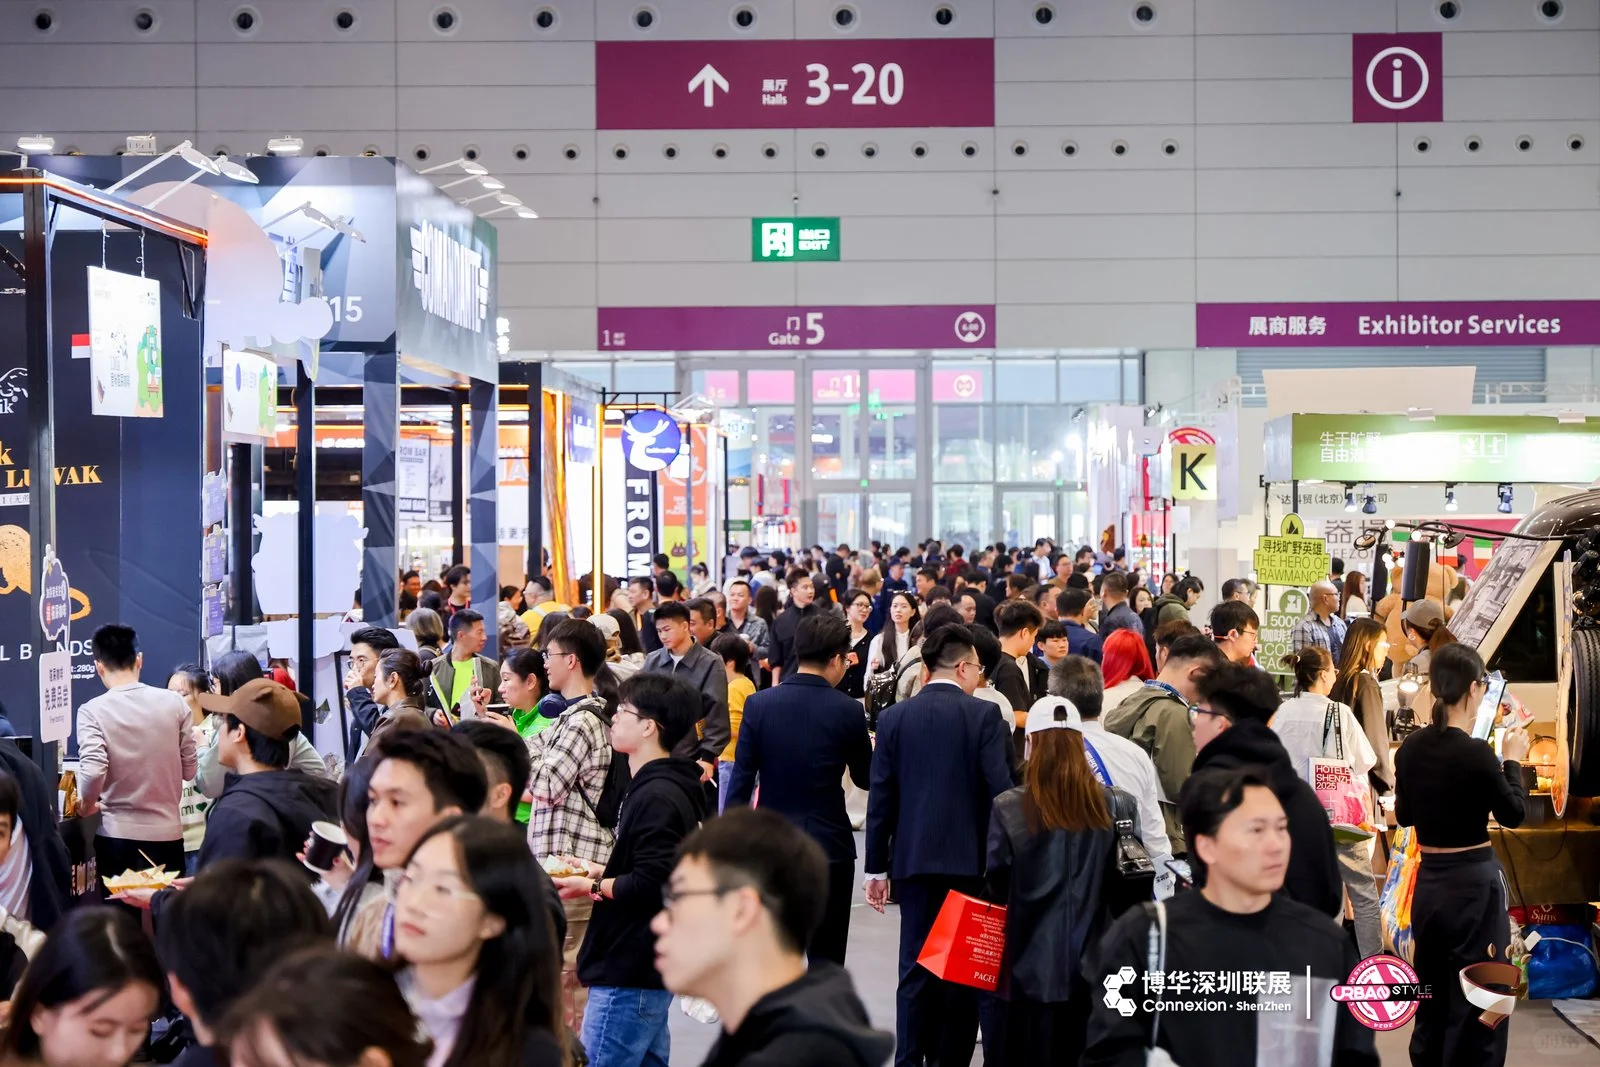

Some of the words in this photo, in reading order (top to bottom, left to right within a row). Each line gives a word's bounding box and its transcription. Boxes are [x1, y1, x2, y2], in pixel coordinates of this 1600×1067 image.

[762, 79, 788, 92] 展厅
[805, 62, 905, 106] 3-20
[762, 94, 788, 105] Halls
[799, 240, 830, 250] EXIT
[786, 316, 800, 331] 门
[805, 312, 825, 345] 5
[1248, 315, 1327, 336] 展商服务
[1358, 314, 1463, 335] Exhibitor
[1467, 313, 1562, 335] Services
[768, 332, 800, 345] Gate
[1180, 452, 1208, 491] K
[626, 477, 652, 578] FROM
[1263, 540, 1323, 556] 寻找旷野英雄
[1256, 553, 1277, 568] THE
[1279, 556, 1311, 570] HERO
[1313, 557, 1330, 570] OF
[1316, 765, 1351, 775] HOTELE
[1316, 773, 1351, 784] SHENZH
[1316, 782, 1337, 790] 2025
